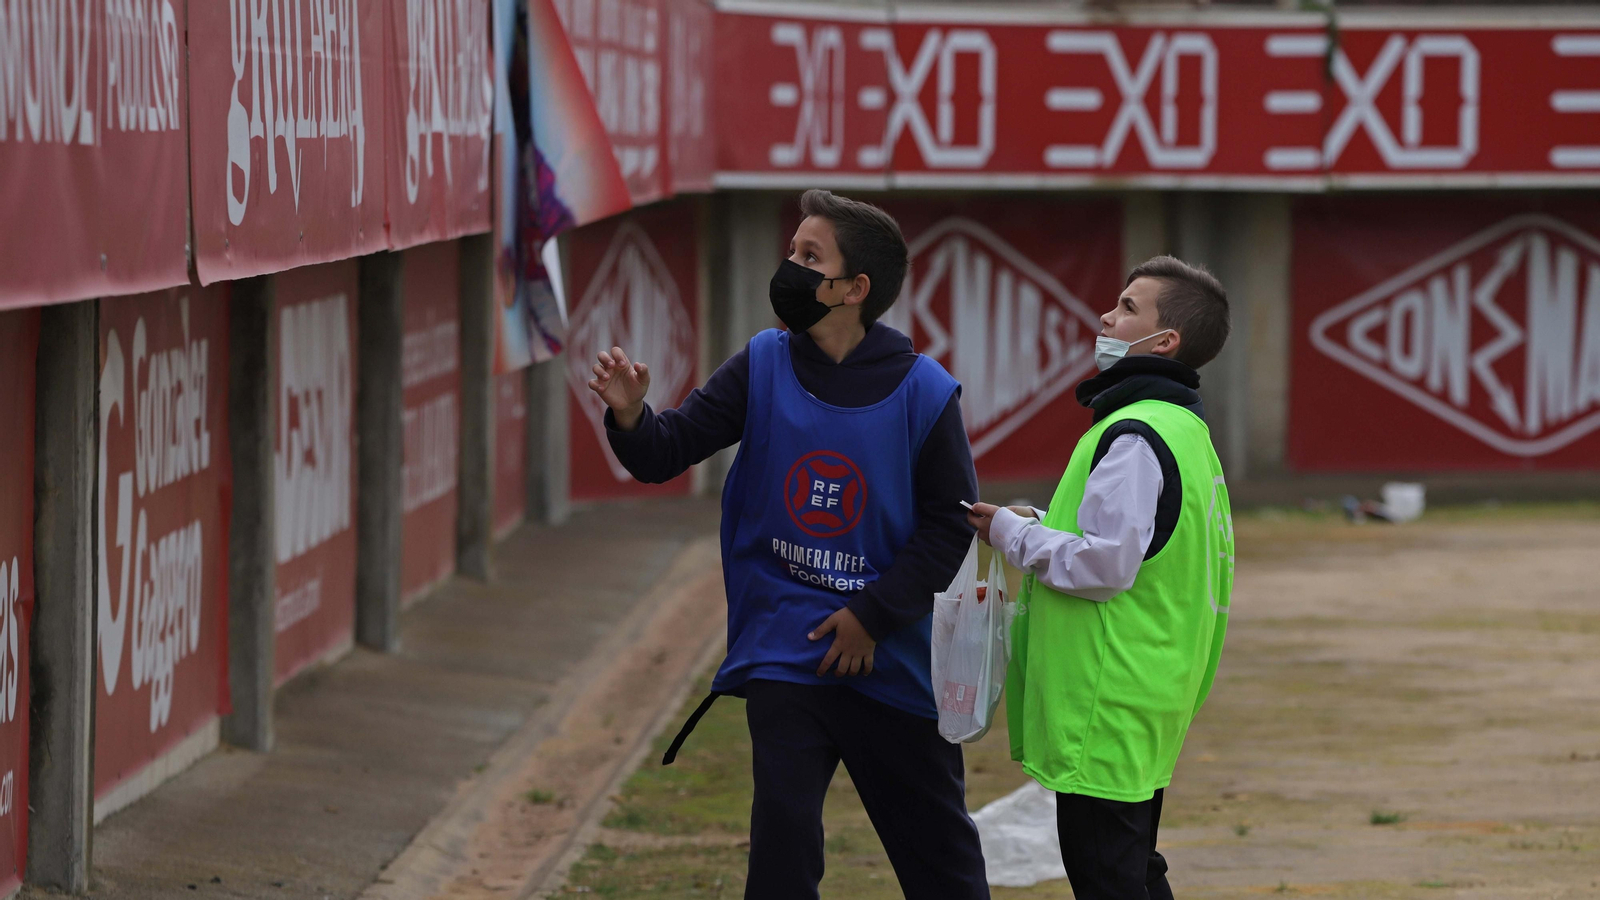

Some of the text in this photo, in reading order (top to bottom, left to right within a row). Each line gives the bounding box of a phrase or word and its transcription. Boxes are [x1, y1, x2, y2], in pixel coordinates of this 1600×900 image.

[1043, 30, 1219, 170] EXO
[1264, 33, 1482, 170] EXO
[772, 538, 865, 573] PRIMERA RFEF
[788, 563, 865, 591] Footters
